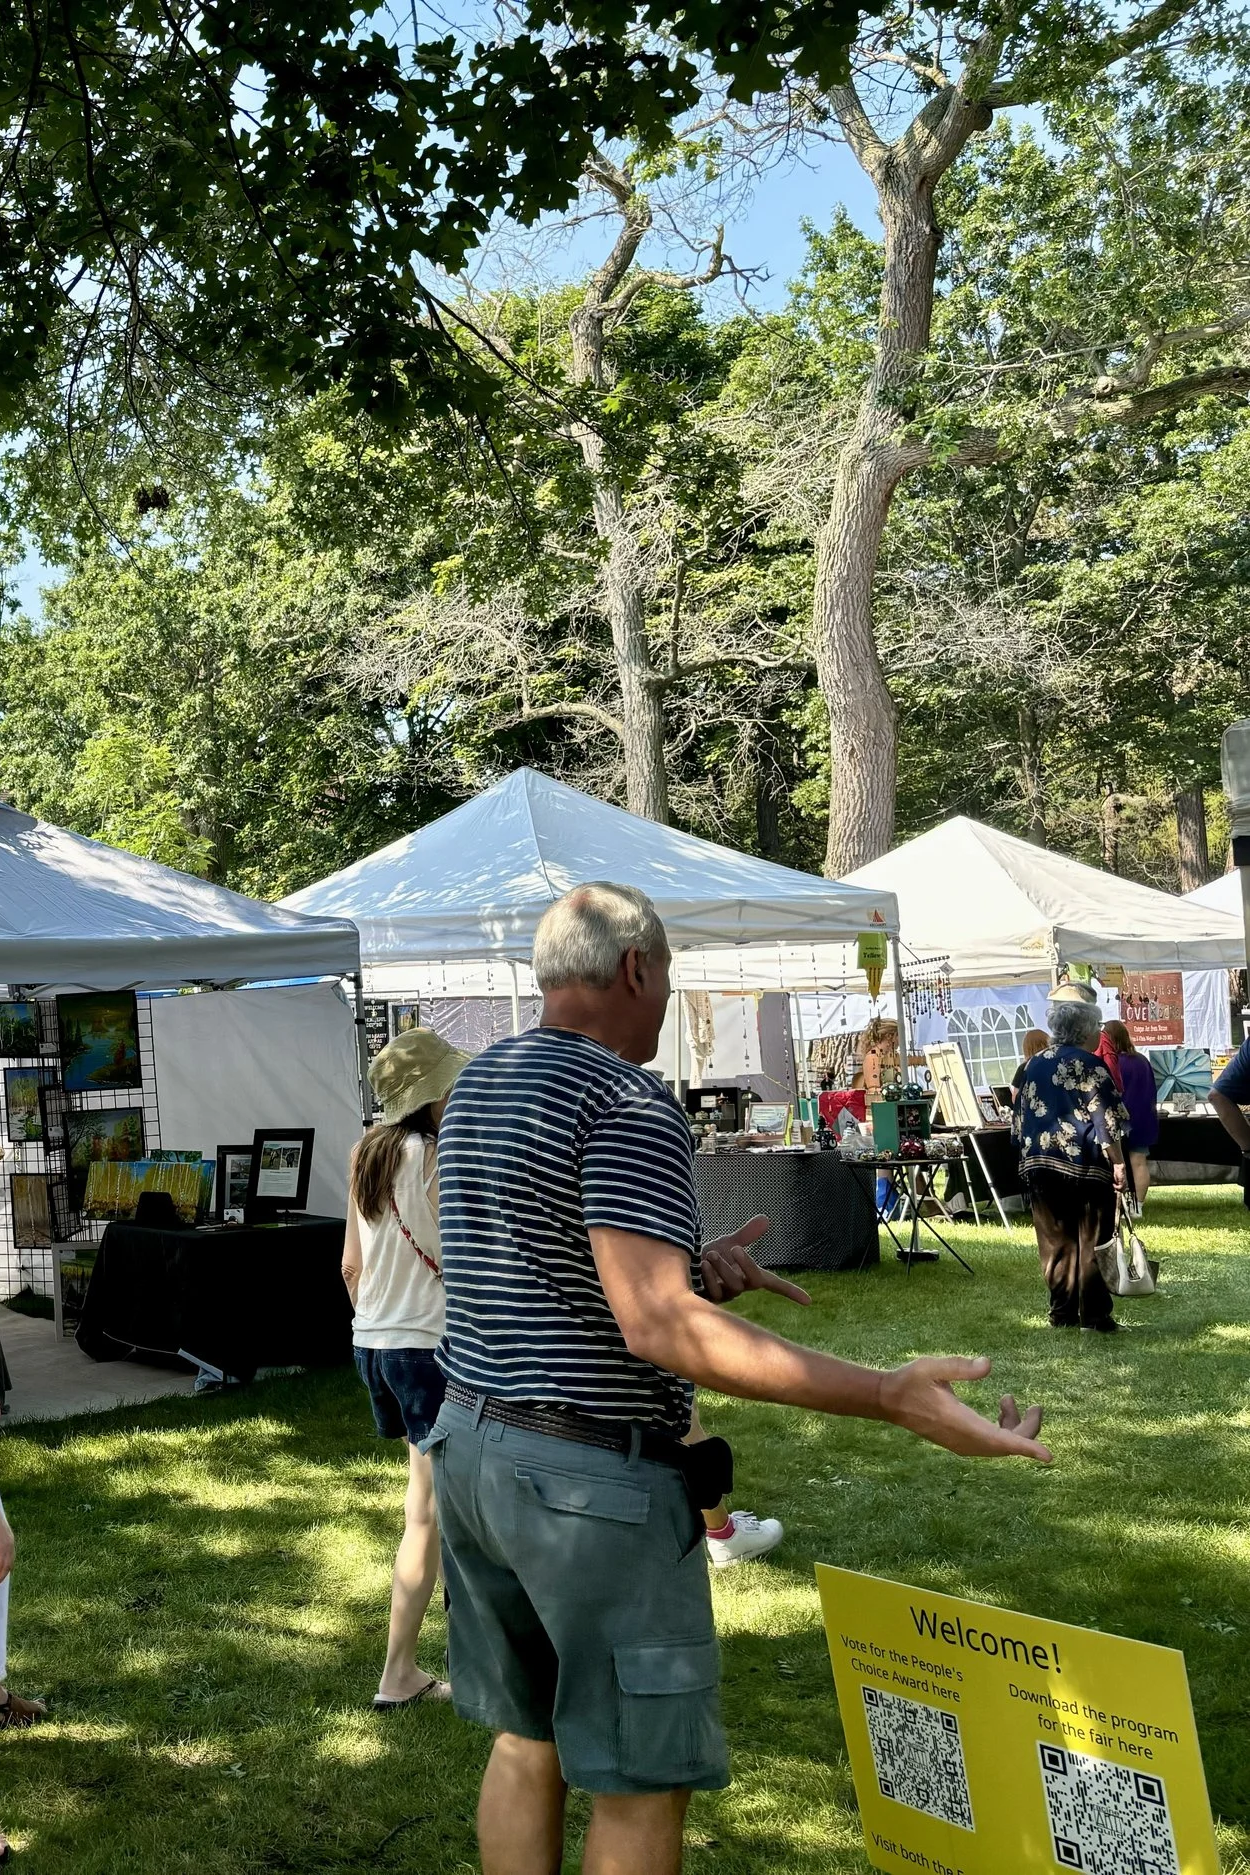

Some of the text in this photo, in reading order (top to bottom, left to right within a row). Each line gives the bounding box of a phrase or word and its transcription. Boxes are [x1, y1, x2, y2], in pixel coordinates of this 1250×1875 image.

[840, 1634, 964, 1682] Vote for the People's
[910, 1606, 1062, 1674] Welcome!
[851, 1657, 961, 1703] Choice Award here
[1009, 1683, 1179, 1744] Download the program
[1038, 1713, 1154, 1760] for the fair here
[871, 1831, 954, 1875] Visit both the
